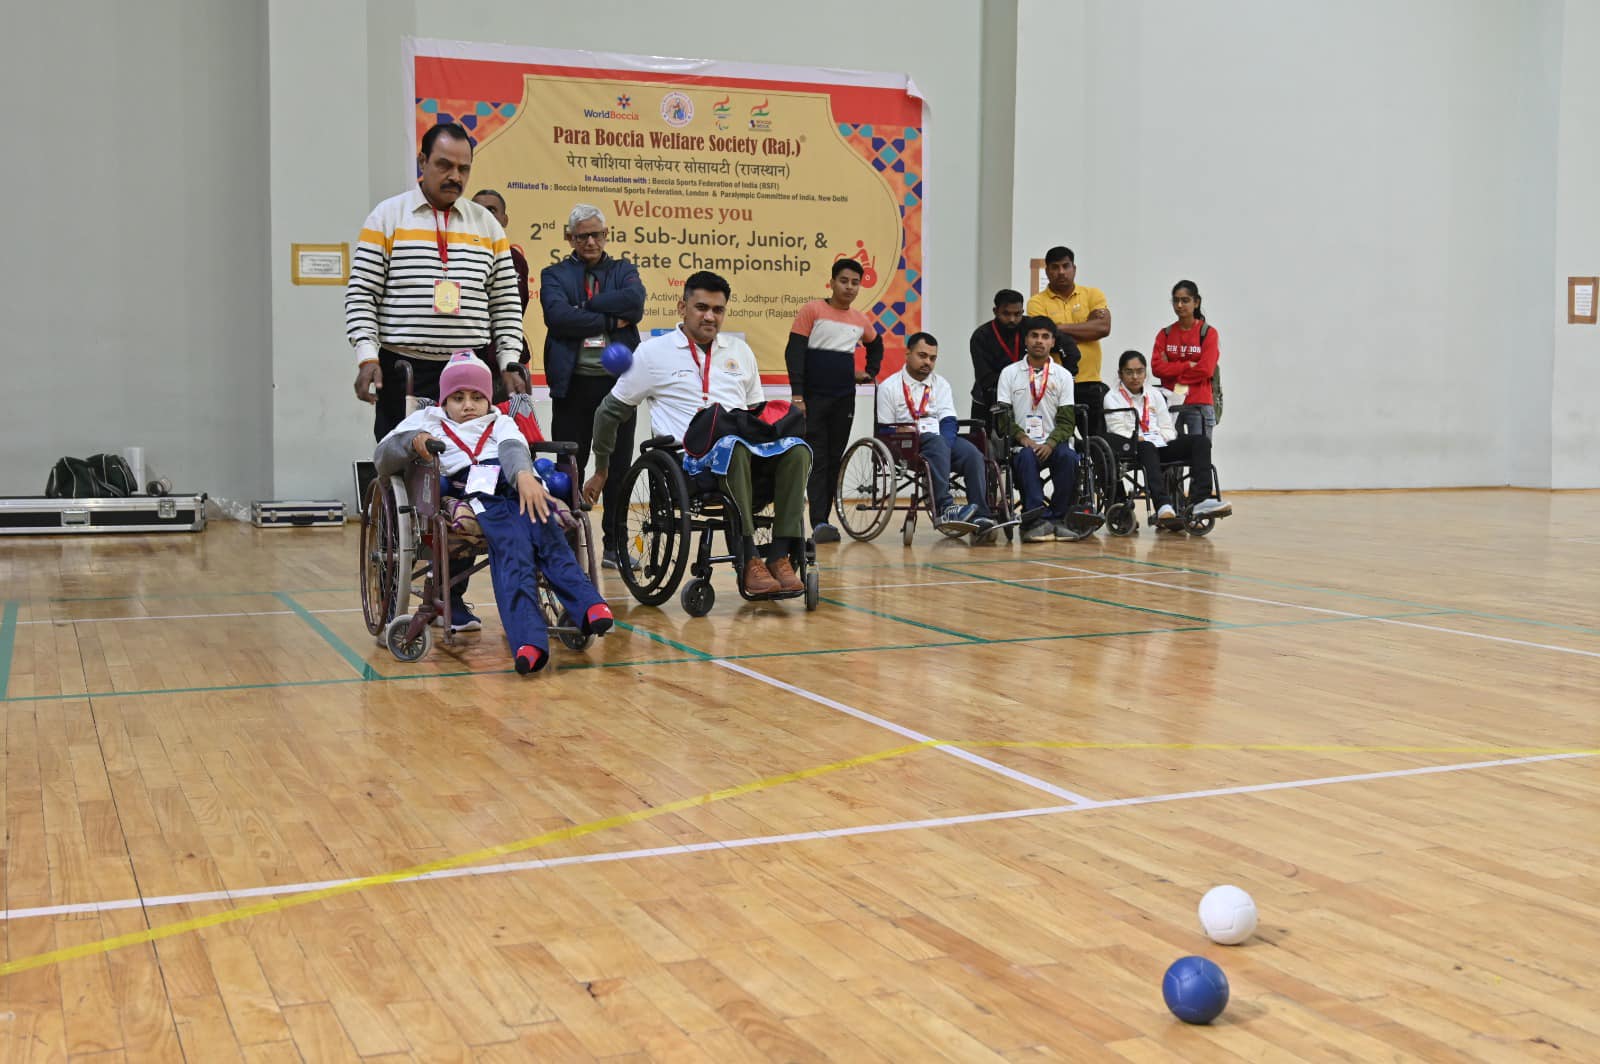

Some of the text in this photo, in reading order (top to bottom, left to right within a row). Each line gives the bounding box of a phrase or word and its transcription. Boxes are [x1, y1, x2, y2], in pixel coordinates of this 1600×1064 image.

[584, 109, 639, 120] WorldBoccia
[553, 126, 801, 157] Para Boccia Welfare Society (Raj.)
[566, 150, 790, 180] पेरा बोशिया वेलफेयर सोसायटी (राजस्थान)
[507, 181, 540, 190] Affiliated
[554, 184, 577, 192] Boccia
[578, 184, 622, 193] International
[623, 186, 645, 195] Sports
[685, 189, 709, 197] London
[720, 190, 756, 200] Paralympic
[756, 192, 790, 200] Committee
[818, 194, 831, 202] New
[584, 174, 591, 182] In
[592, 175, 631, 184] Association
[632, 176, 647, 184] with
[652, 177, 675, 185] Boccia
[676, 178, 697, 188] Sports
[698, 180, 732, 188] Federation
[741, 181, 758, 189] India
[613, 199, 752, 225] Welcomes you
[634, 226, 740, 249] Sub-Junior,
[746, 230, 807, 251] Junior,
[814, 231, 828, 248] &
[678, 252, 811, 277] Championship
[743, 294, 778, 304] Jodhpur
[727, 308, 763, 318] Jodhpur
